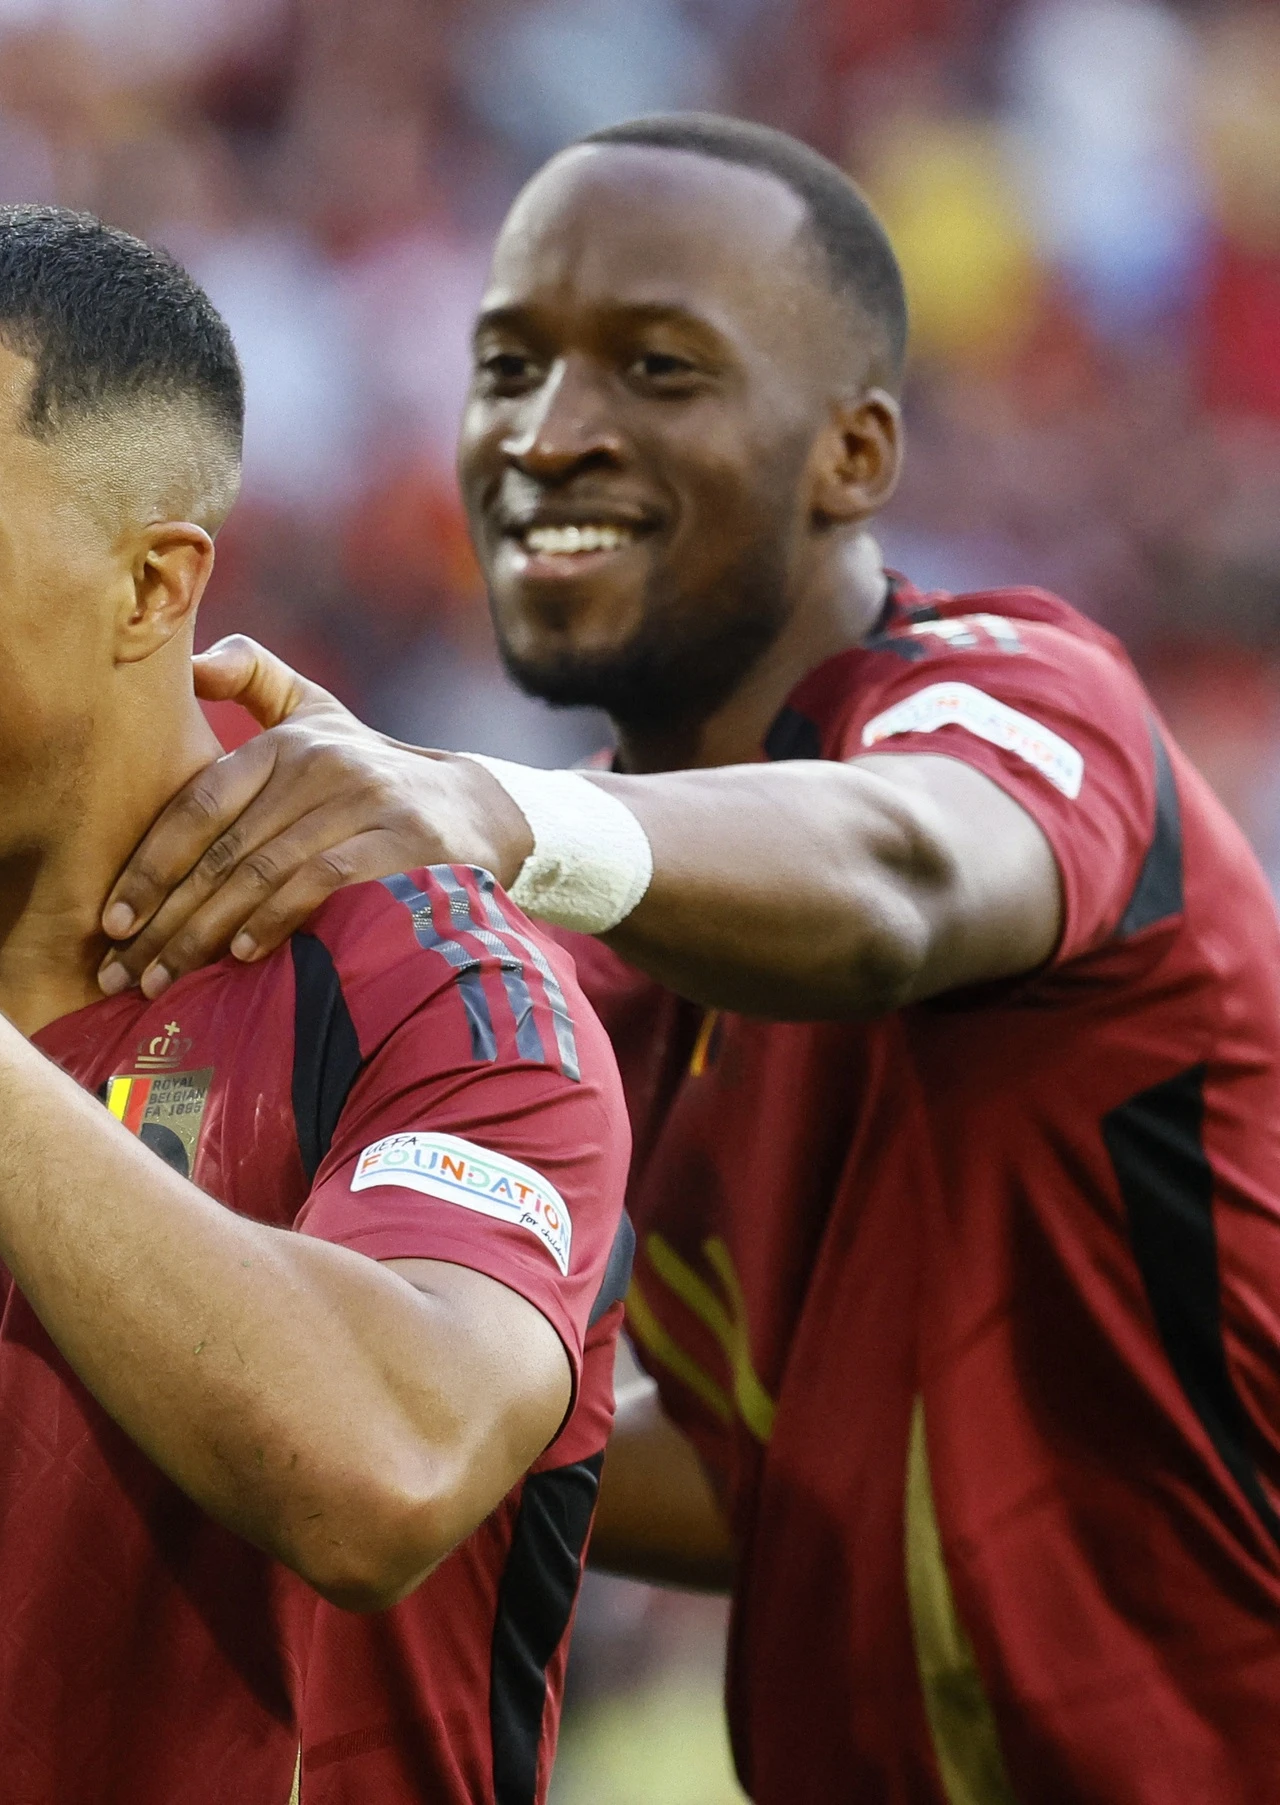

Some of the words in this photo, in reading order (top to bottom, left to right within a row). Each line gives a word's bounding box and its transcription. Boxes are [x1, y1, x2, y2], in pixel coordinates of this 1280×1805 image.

[153, 1076, 194, 1091] ROYAL
[149, 1087, 206, 1104] BELGIAN
[145, 1105, 161, 1118] FA
[366, 1136, 419, 1156] UEFA
[520, 1212, 538, 1225] for
